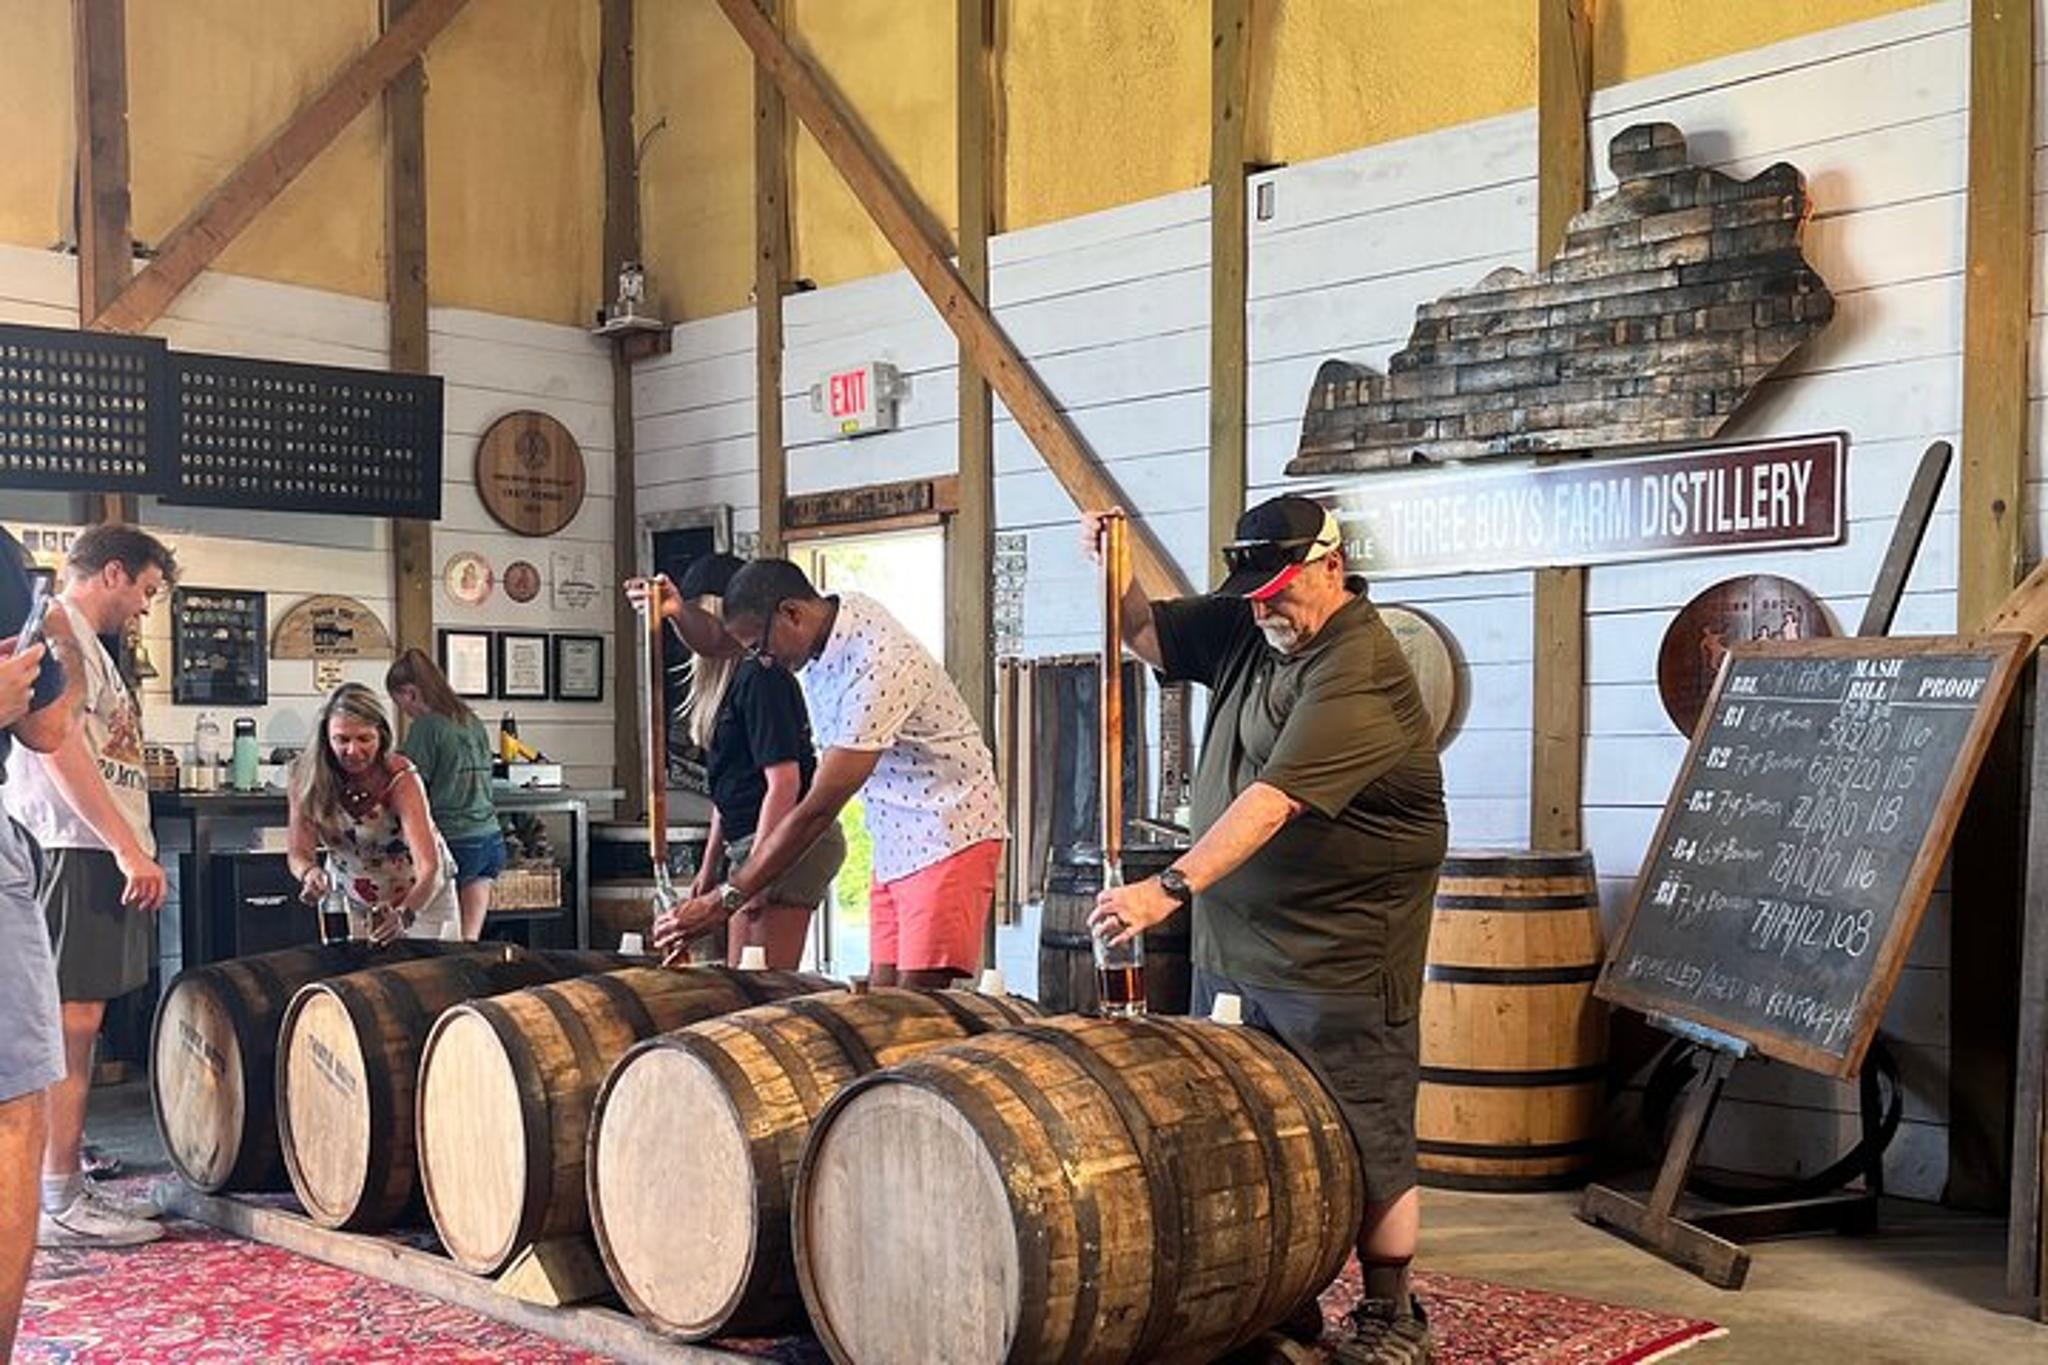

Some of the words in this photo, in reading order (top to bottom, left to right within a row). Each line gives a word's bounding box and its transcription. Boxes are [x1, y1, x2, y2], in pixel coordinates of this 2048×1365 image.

[252, 379, 316, 394] FORGET
[332, 385, 350, 398] TO
[830, 370, 866, 416] EXIT
[1390, 497, 1466, 556] THREE
[1475, 487, 1543, 549] BOYS
[1554, 479, 1631, 545] FARM
[1640, 461, 1812, 538] DISTILLERY
[1344, 539, 1374, 559] ILE
[1850, 659, 1903, 677] MASH
[1848, 681, 1888, 701] BILL
[1916, 676, 1986, 698] PROOF
[1825, 909, 1875, 957] 108
